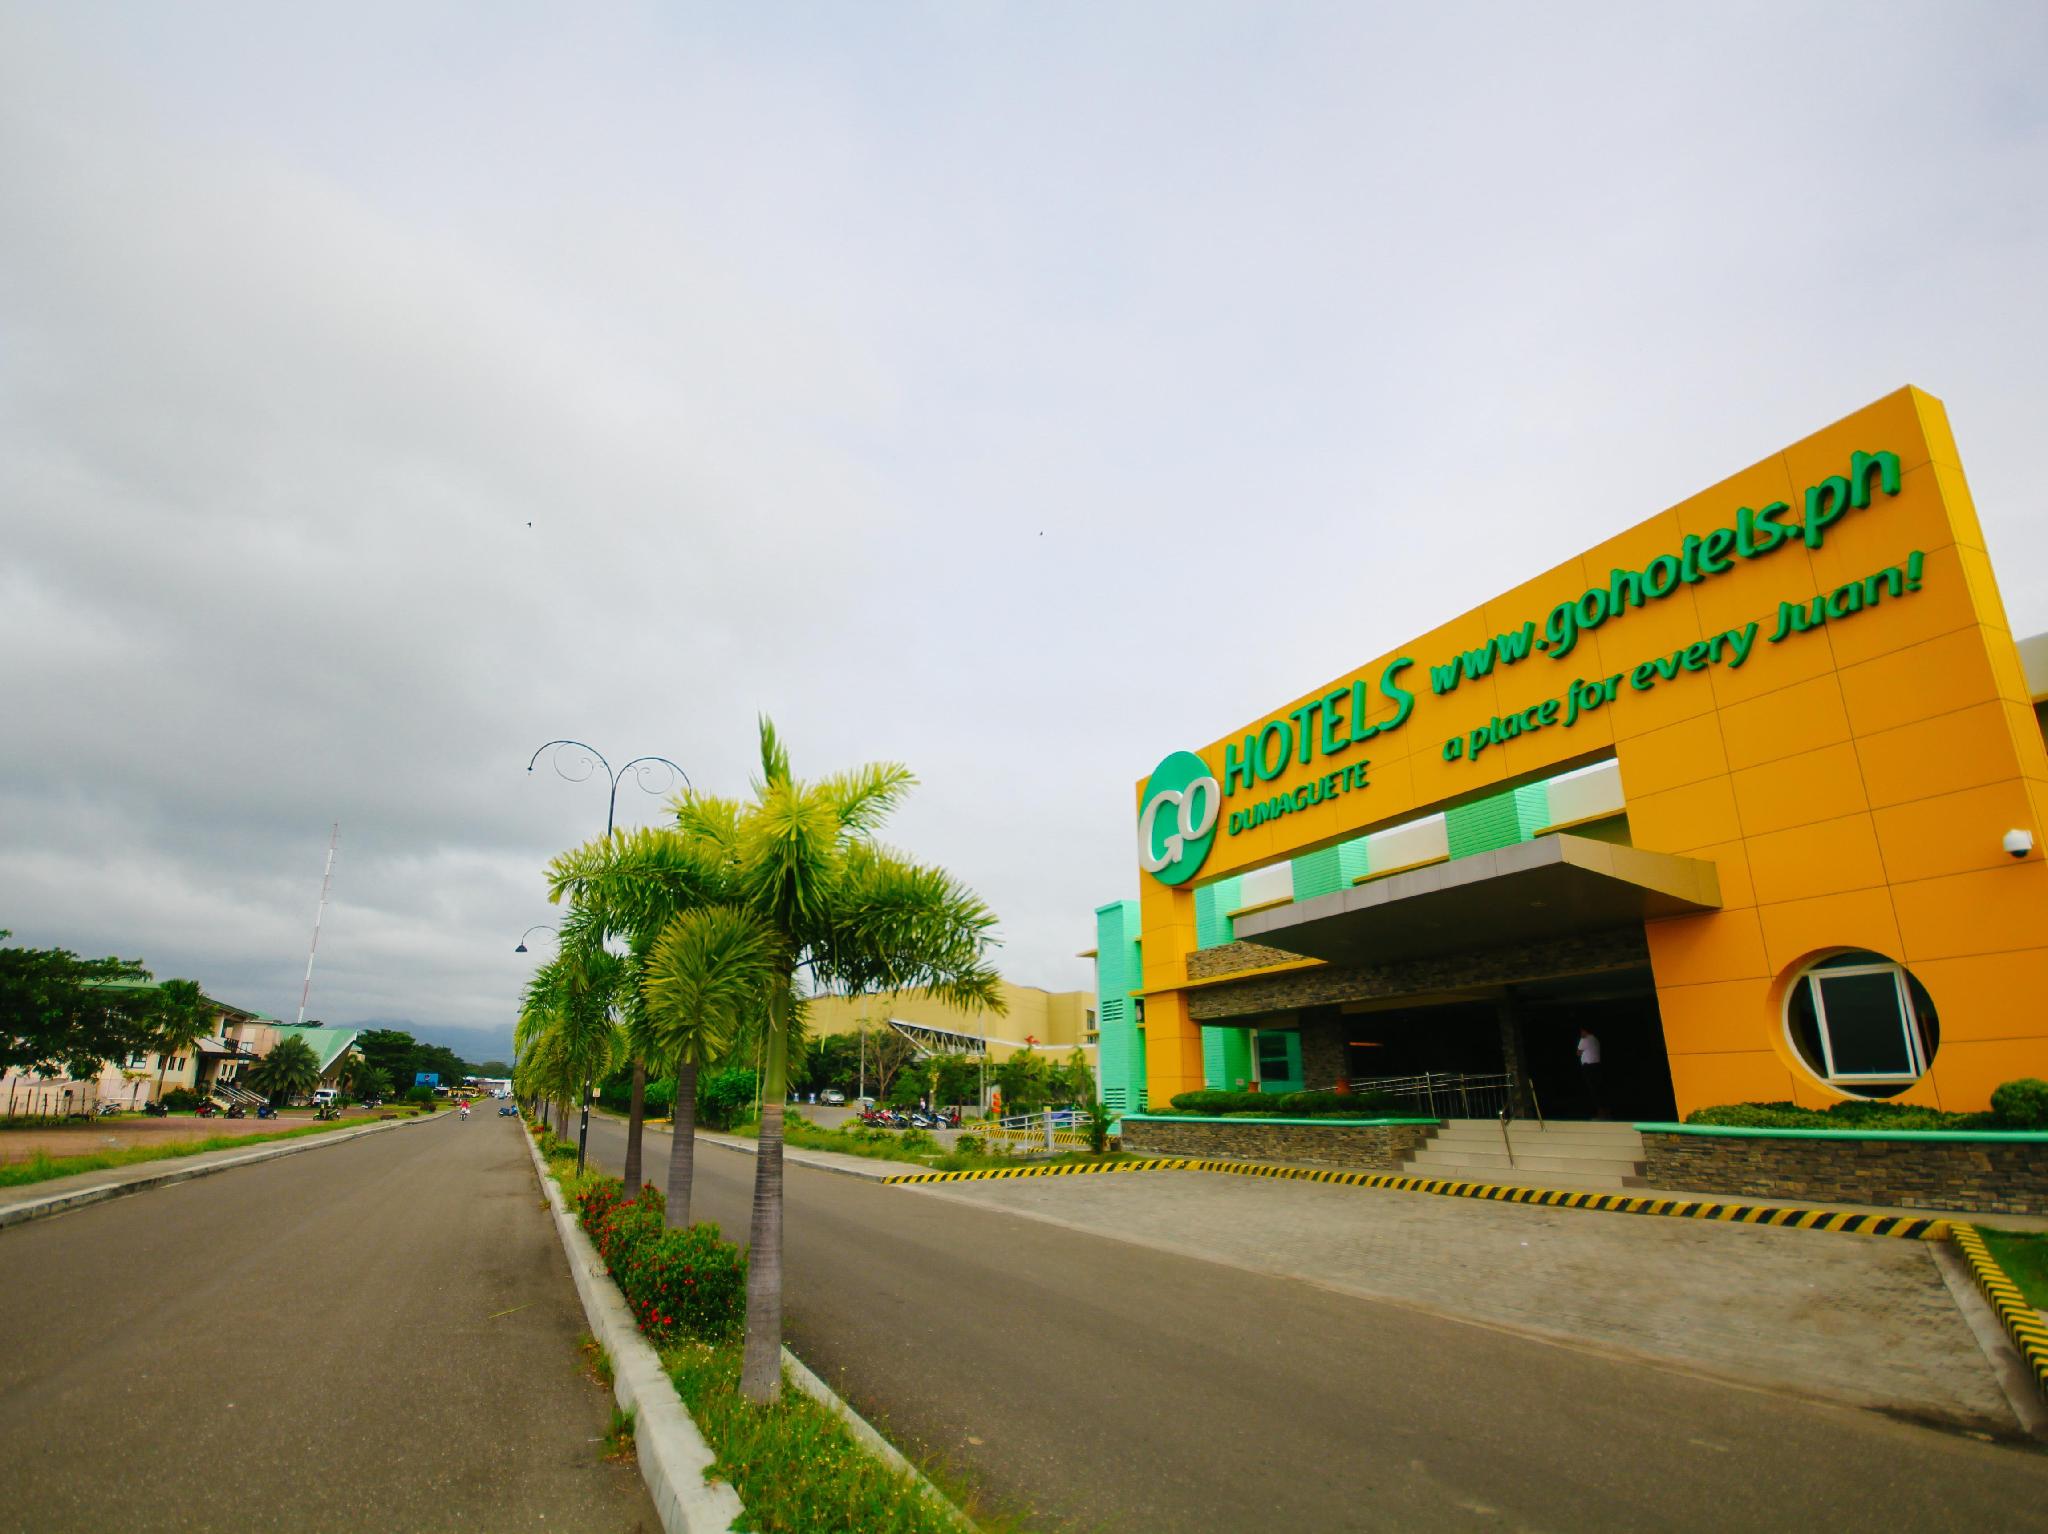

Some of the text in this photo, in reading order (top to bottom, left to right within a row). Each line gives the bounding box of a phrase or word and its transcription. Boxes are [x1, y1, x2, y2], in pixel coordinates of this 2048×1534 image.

[1430, 450, 1901, 695] www.gohotels.ph
[1442, 550, 1925, 762] a place for every Juan!
[1223, 657, 1415, 797] HOTELS
[1138, 776, 1221, 873] GO
[1228, 759, 1370, 836] DUMAGUETE
